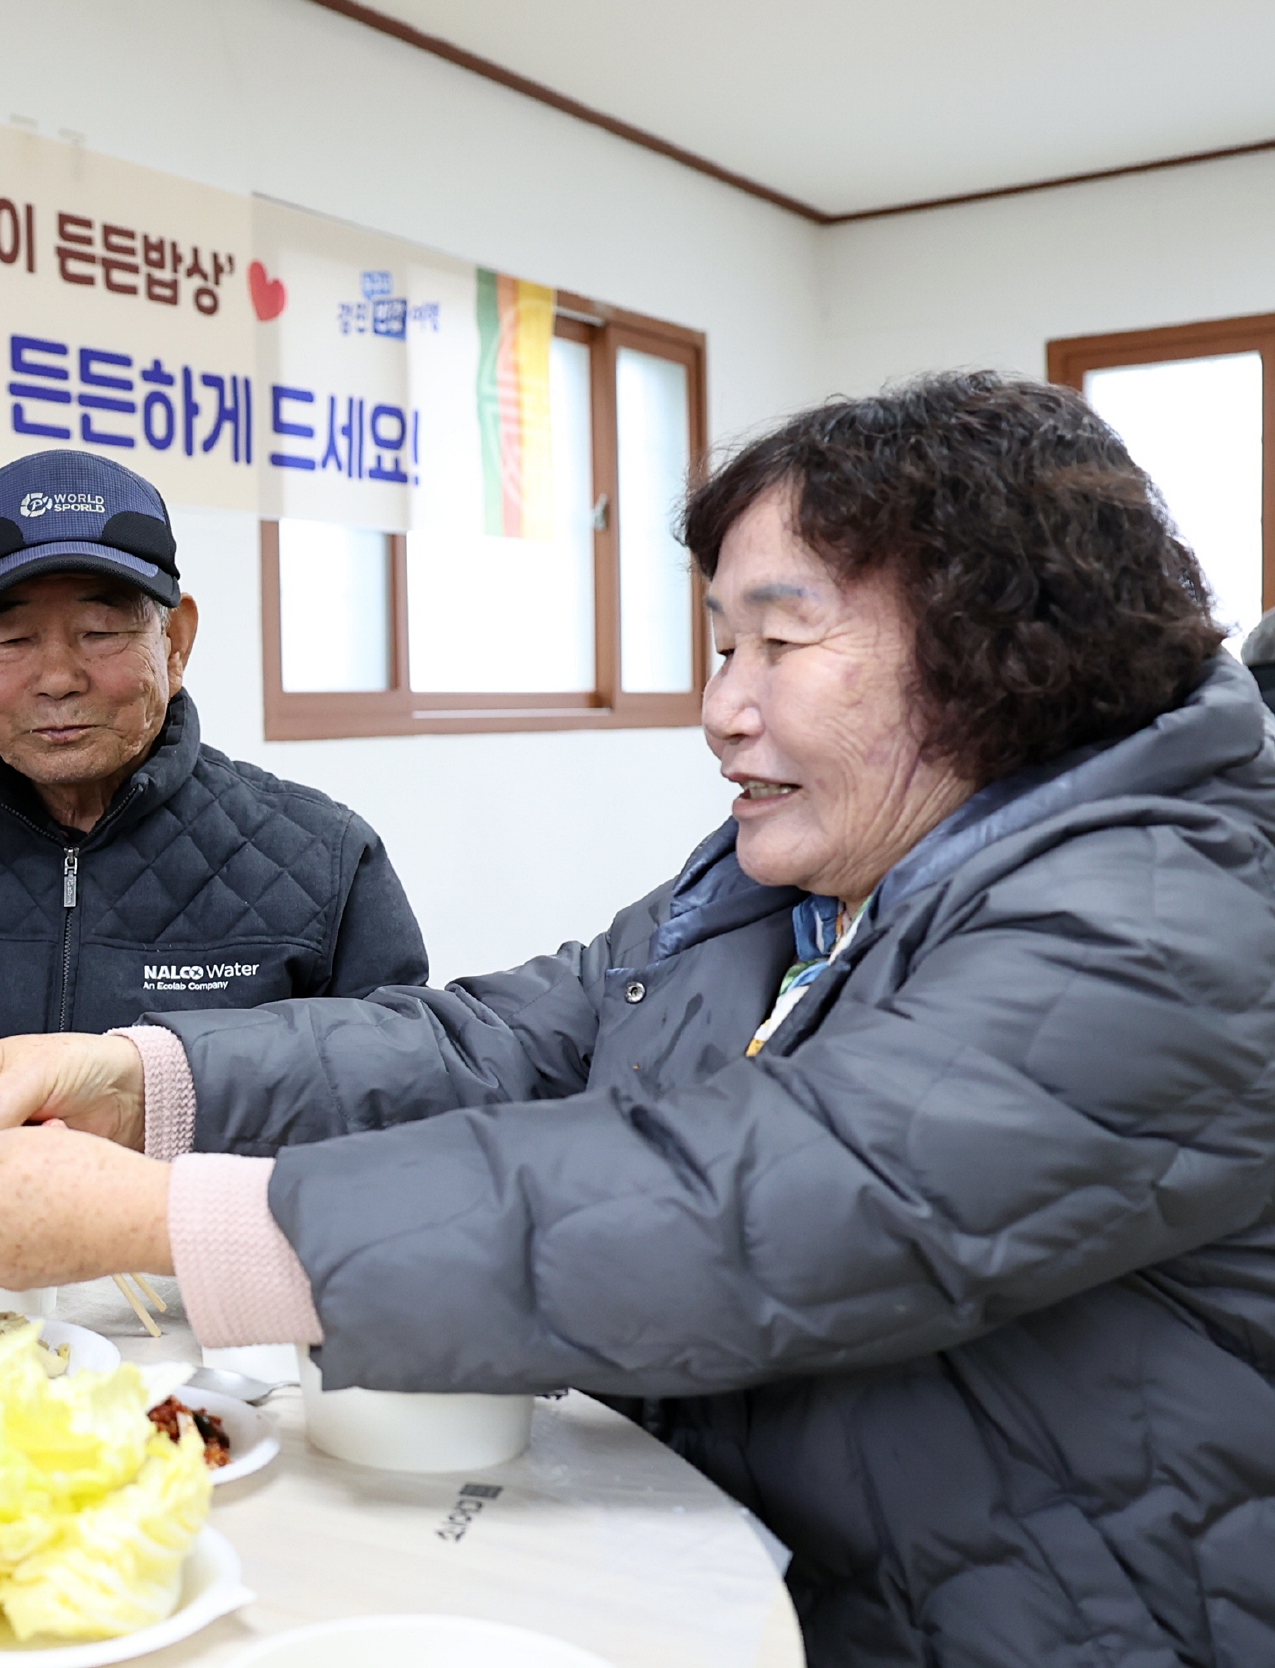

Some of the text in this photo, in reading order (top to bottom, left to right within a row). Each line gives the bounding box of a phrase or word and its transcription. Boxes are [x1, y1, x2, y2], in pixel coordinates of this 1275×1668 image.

[8, 334, 252, 465] 든든하게
[270, 385, 419, 486] 드세요!
[54, 493, 104, 504] WORLD
[54, 503, 106, 512] SPORLD
[143, 962, 260, 980] NALCO Water
[143, 981, 229, 991] An Ecolab Company
